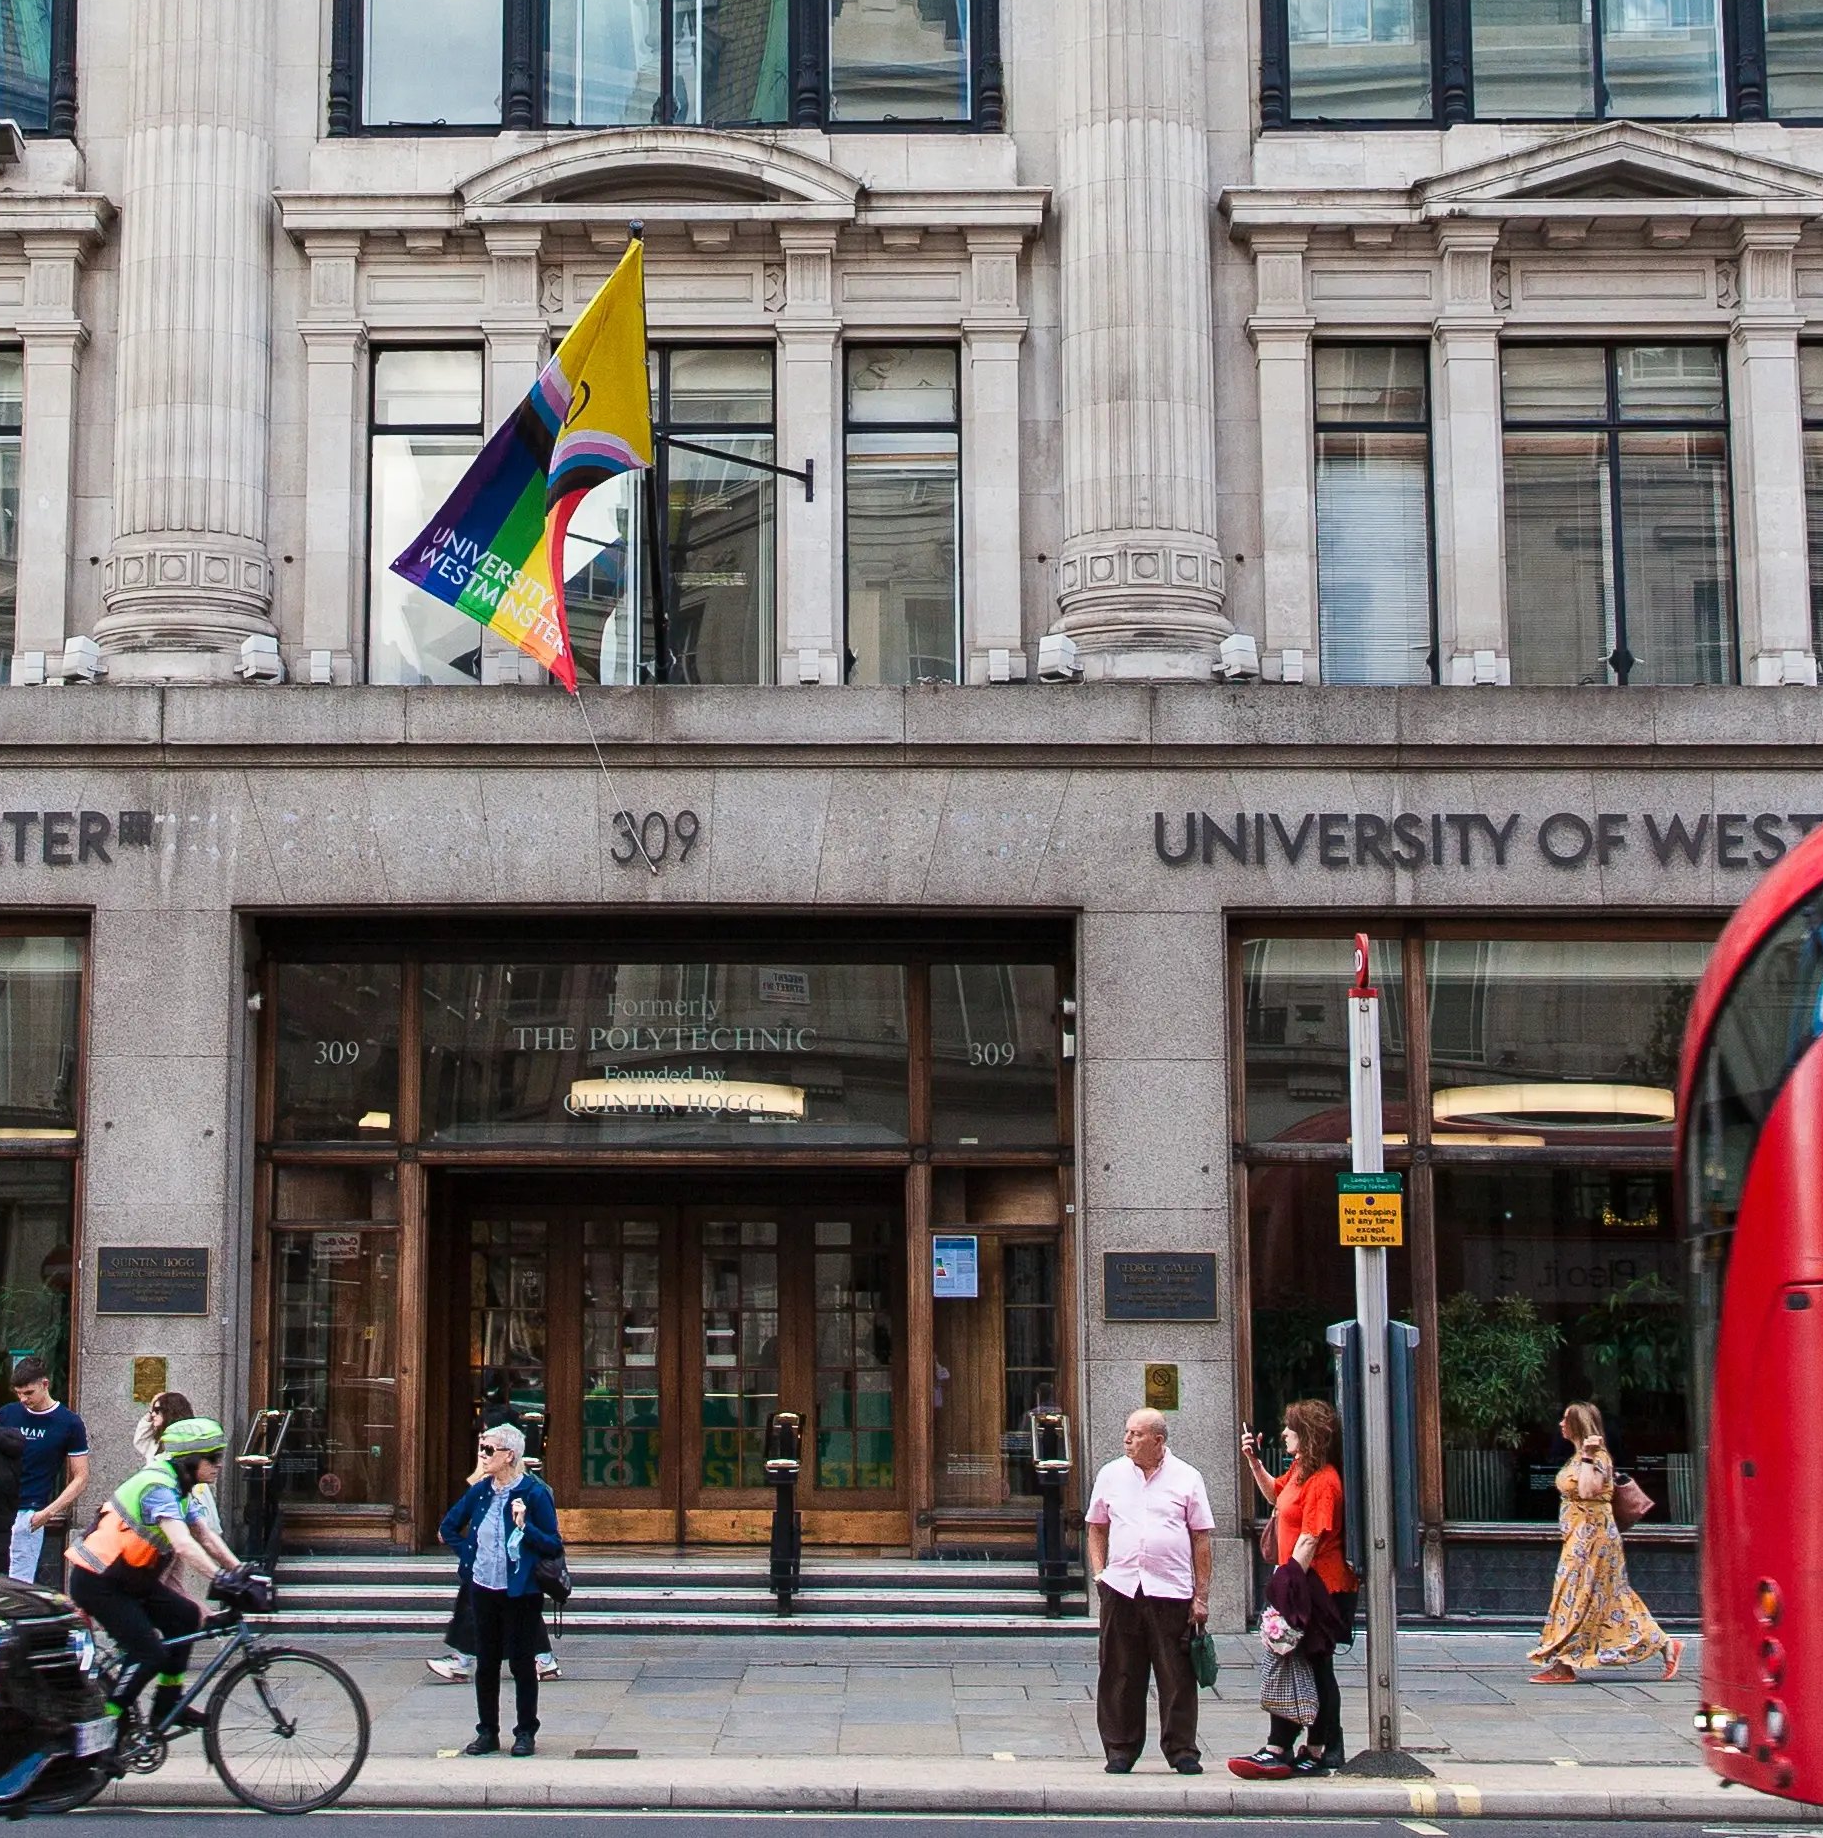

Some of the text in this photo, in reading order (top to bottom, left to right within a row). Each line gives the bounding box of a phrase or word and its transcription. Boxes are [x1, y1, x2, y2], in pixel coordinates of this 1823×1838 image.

[433, 526, 554, 601] UNIVERSITY
[420, 544, 565, 656] WESTMINSTER
[610, 809, 701, 865] 309
[1153, 810, 1522, 866] UNIVERSITY
[1537, 811, 1634, 866] OF
[607, 992, 722, 1020] Formerly
[512, 1026, 817, 1051] THE POLYTECHNIC
[314, 1040, 360, 1065] 309
[969, 1041, 1015, 1066] 309
[603, 1065, 726, 1087] Founded by
[562, 1093, 765, 1117] QUINTIN HOGG
[1359, 1208, 1397, 1217] stopping
[111, 1257, 195, 1267] QUINTIN HOGG
